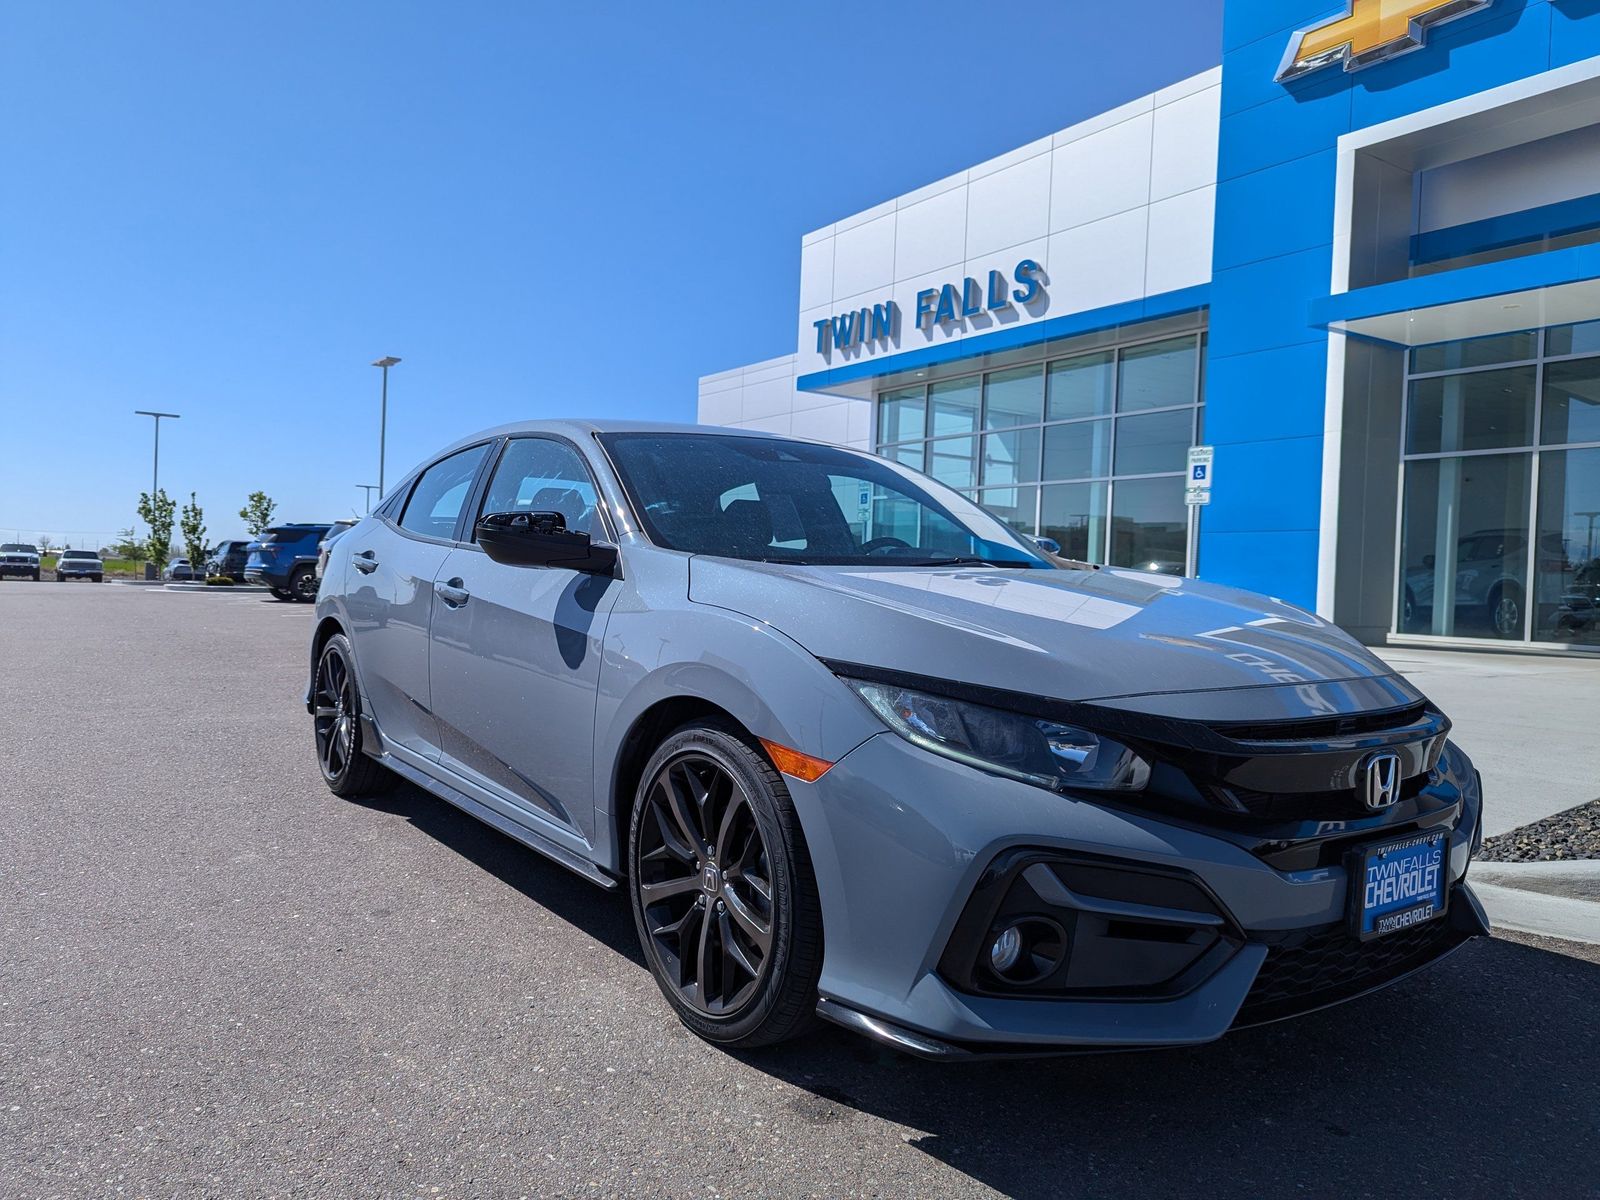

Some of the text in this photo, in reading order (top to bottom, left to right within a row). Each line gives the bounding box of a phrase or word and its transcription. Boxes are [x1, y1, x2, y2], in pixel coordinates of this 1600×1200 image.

[813, 259, 1037, 354] TWIN FALLS
[1364, 864, 1440, 909] CHEVROLET
[1395, 904, 1434, 929] CHEVROLET
